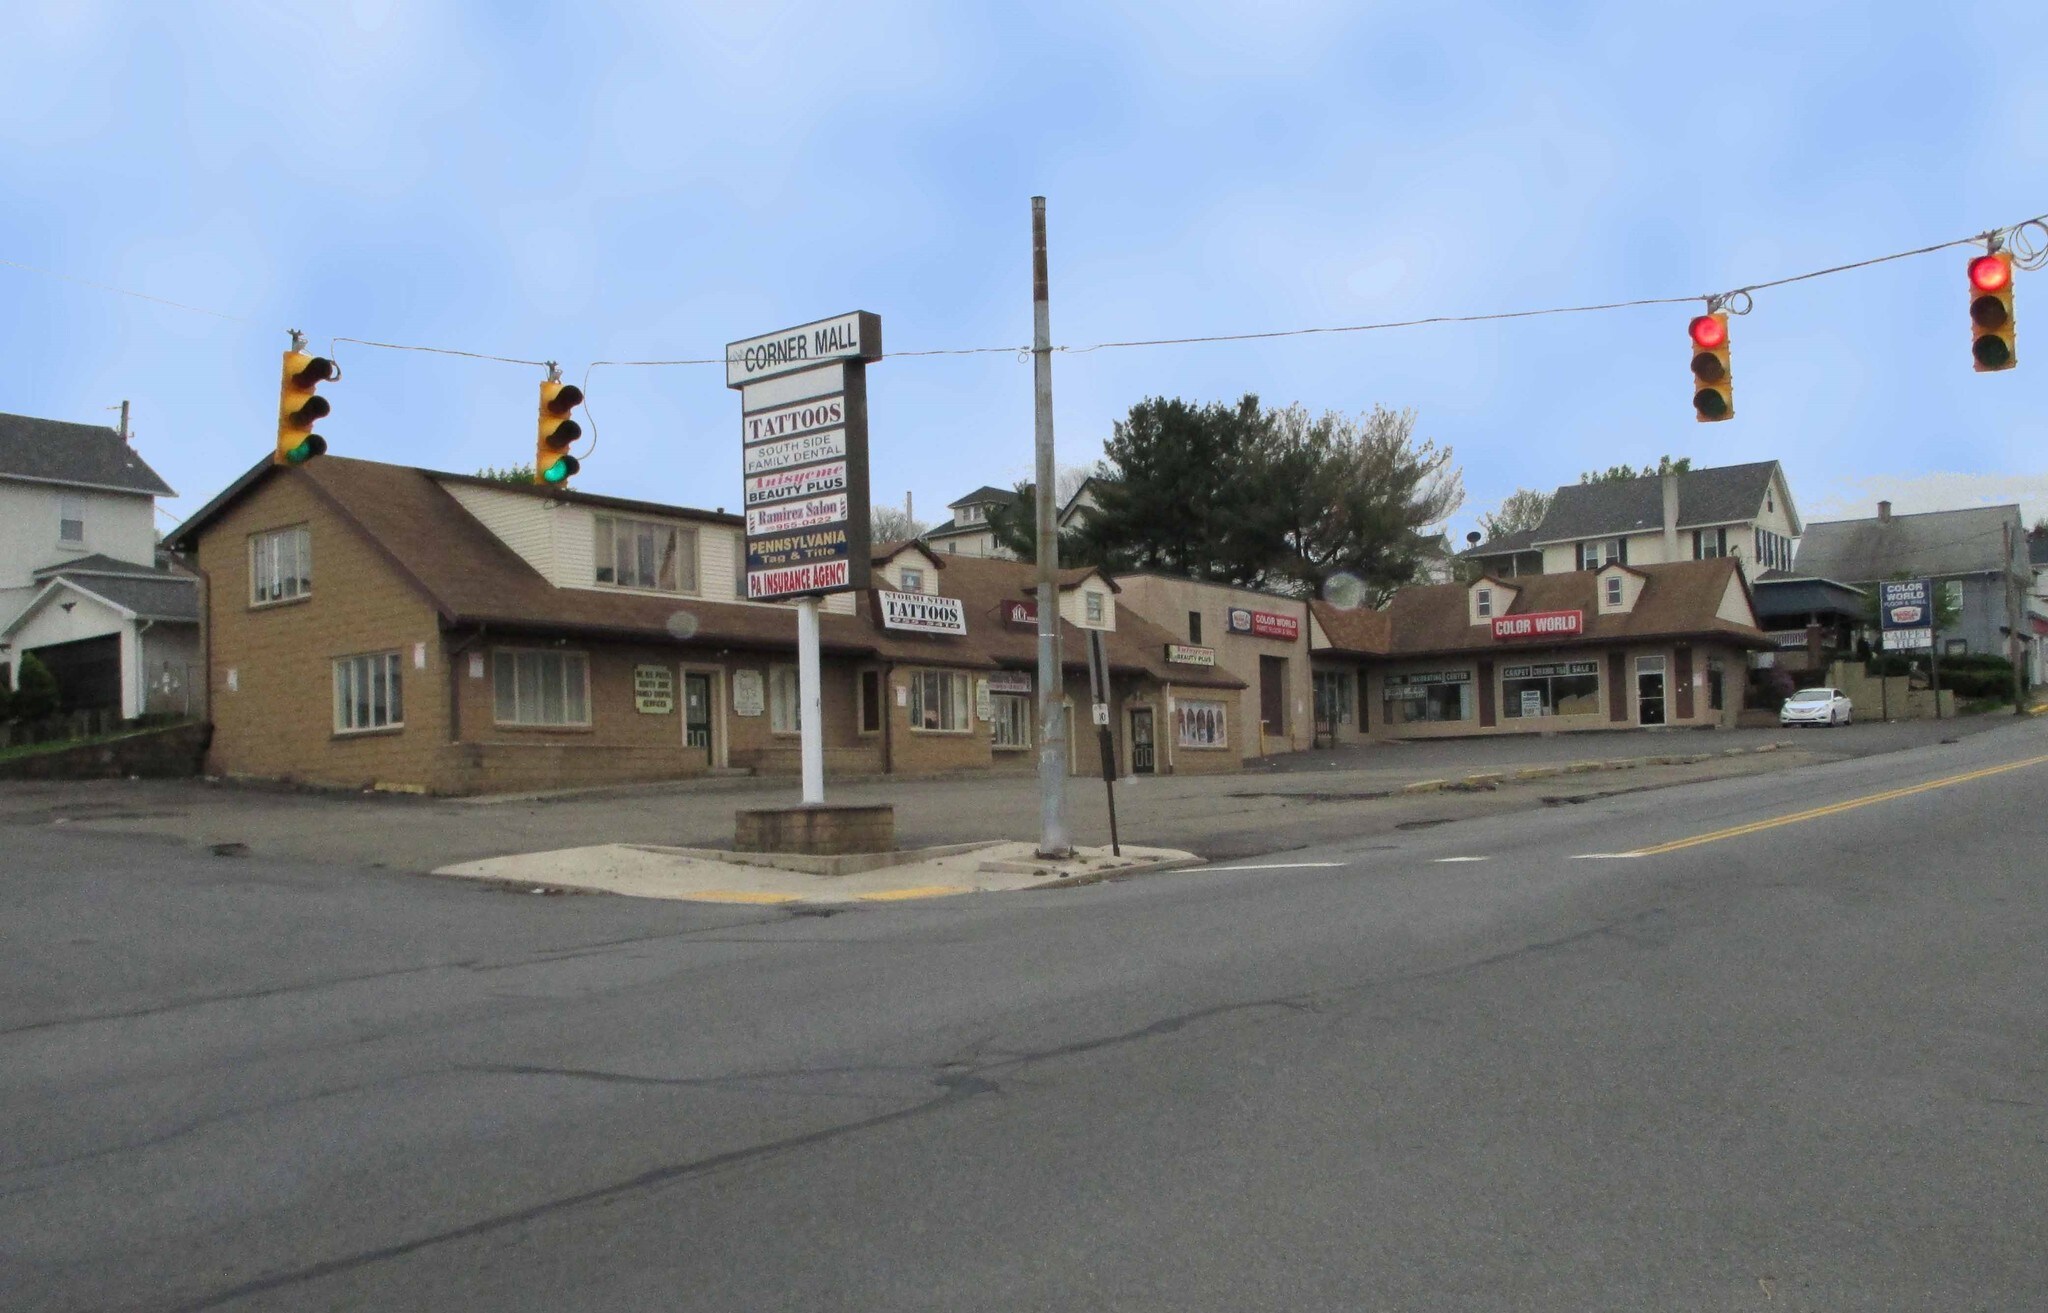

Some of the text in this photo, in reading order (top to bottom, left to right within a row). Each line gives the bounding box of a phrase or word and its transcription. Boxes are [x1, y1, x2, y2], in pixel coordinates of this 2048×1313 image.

[745, 323, 857, 372] CORNER MALL
[749, 402, 841, 439] TATTOOS
[748, 444, 842, 472] FAMILY DENTAL
[758, 434, 831, 458] SOUTH SIDE
[749, 477, 843, 502] BEAUTY PLUS
[758, 500, 837, 526] Ramirez Salon
[750, 530, 846, 556] PENNSYLVANIA
[761, 547, 835, 564] Tag & Title
[750, 562, 846, 597] PA INSURANCE AGENCY
[1887, 583, 1923, 593] COLOR
[1886, 591, 1925, 601] WORLD
[886, 600, 958, 623] TATTOOS
[1256, 614, 1276, 626] COLOR
[1276, 618, 1297, 629] WORLD
[1496, 615, 1577, 636] COLOR WORLD
[1505, 668, 1529, 677] CARPET
[1572, 664, 1590, 673] SALE
